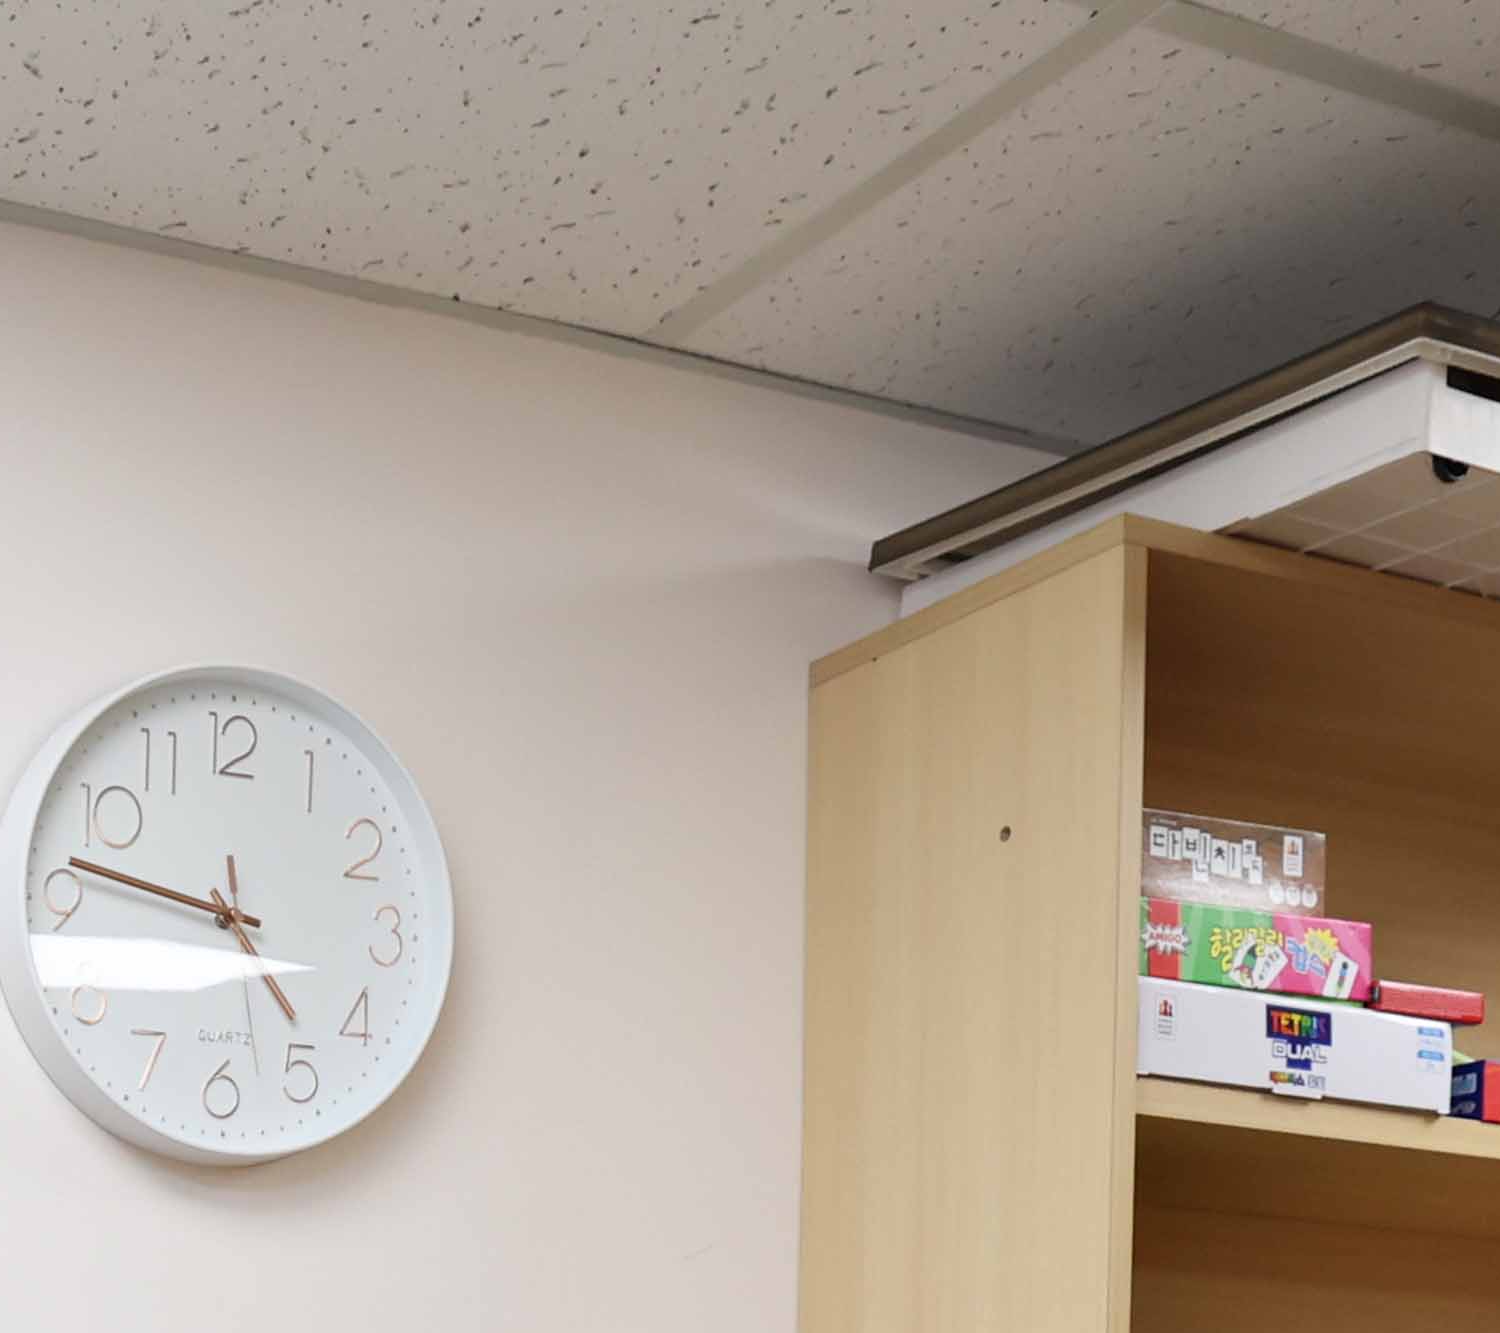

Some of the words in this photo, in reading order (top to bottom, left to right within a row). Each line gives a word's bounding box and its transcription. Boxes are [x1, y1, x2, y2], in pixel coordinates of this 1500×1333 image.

[140, 727, 177, 795] 11
[208, 710, 259, 779] 12
[304, 749, 315, 814] 1
[80, 782, 144, 849] 10
[342, 817, 383, 881] 2
[43, 867, 84, 932] 9
[368, 903, 403, 967] 3
[197, 1028, 253, 1047] QUARTZ
[338, 985, 374, 1047] 4
[130, 1028, 168, 1093] 7
[283, 1042, 320, 1104] 5
[1272, 1039, 1329, 1065] DUAL
[201, 1058, 241, 1120] 6
